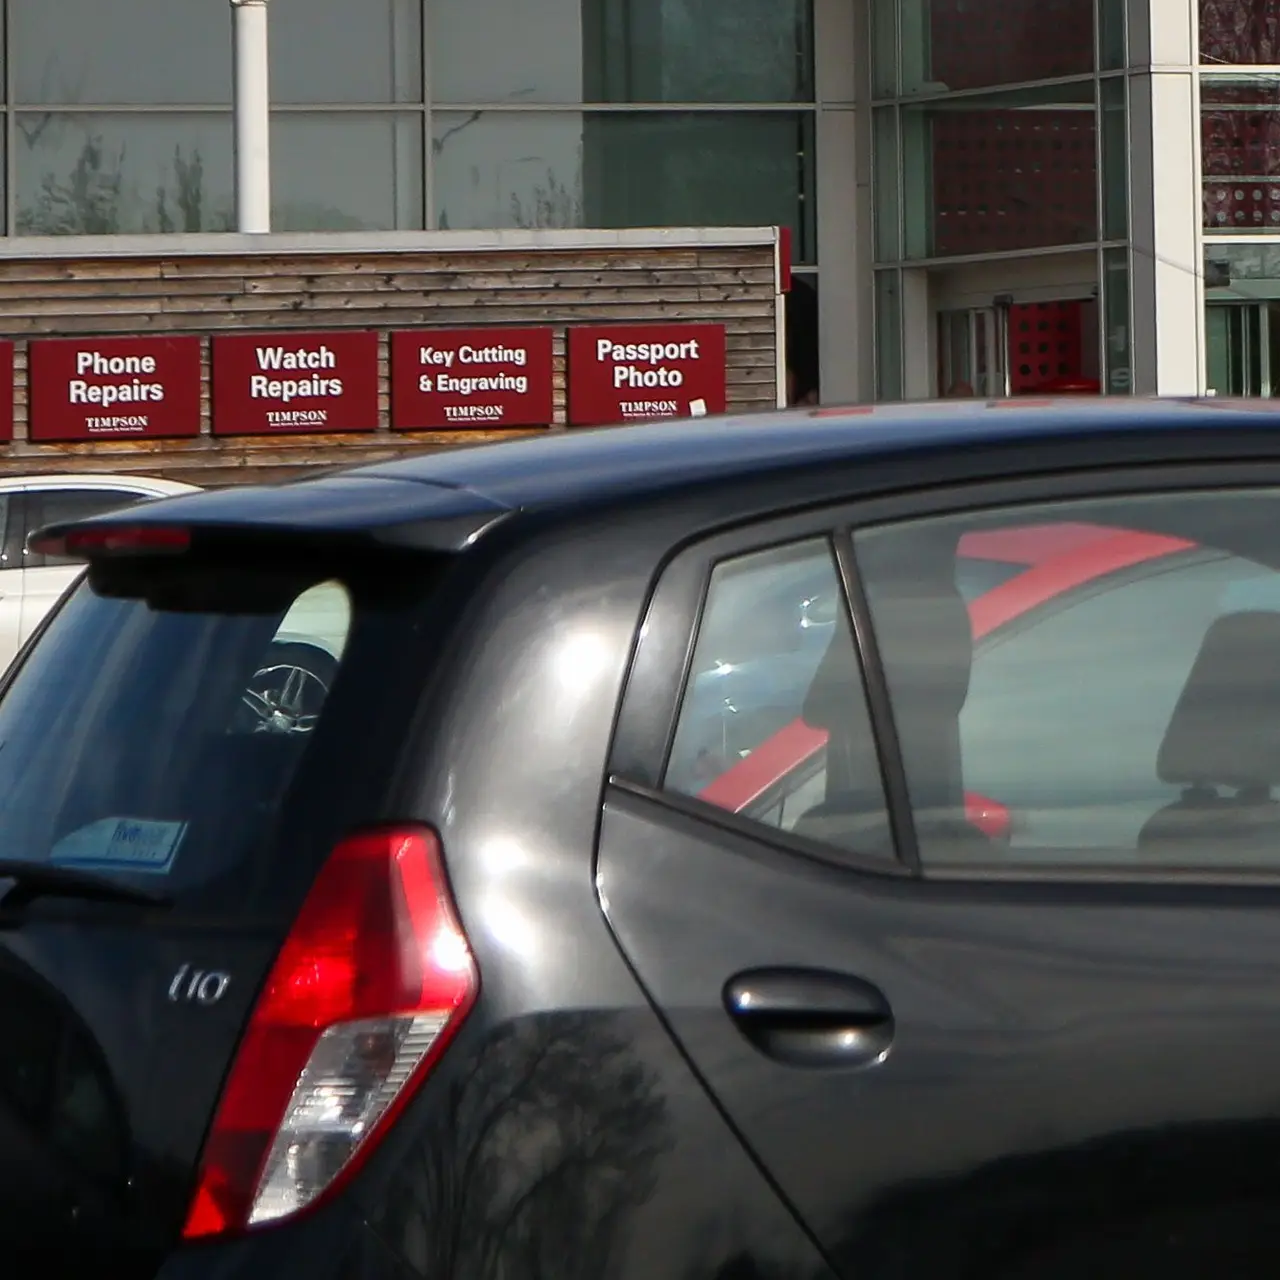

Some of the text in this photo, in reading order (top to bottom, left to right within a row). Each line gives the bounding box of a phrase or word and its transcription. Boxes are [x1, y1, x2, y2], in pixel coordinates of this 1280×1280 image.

[77, 351, 156, 375] Phone
[256, 345, 336, 370] Watch
[420, 345, 527, 367] Key Cutting
[597, 339, 699, 365] Passport
[250, 373, 343, 402] Repairs
[419, 373, 527, 395] & Engraving
[613, 365, 683, 388] Photo
[69, 378, 164, 407] Repairs
[266, 410, 328, 423] TIMPSON
[443, 405, 504, 417] TIMPSON
[619, 400, 677, 412] TIMPSON
[85, 415, 148, 428] TIMPSON
